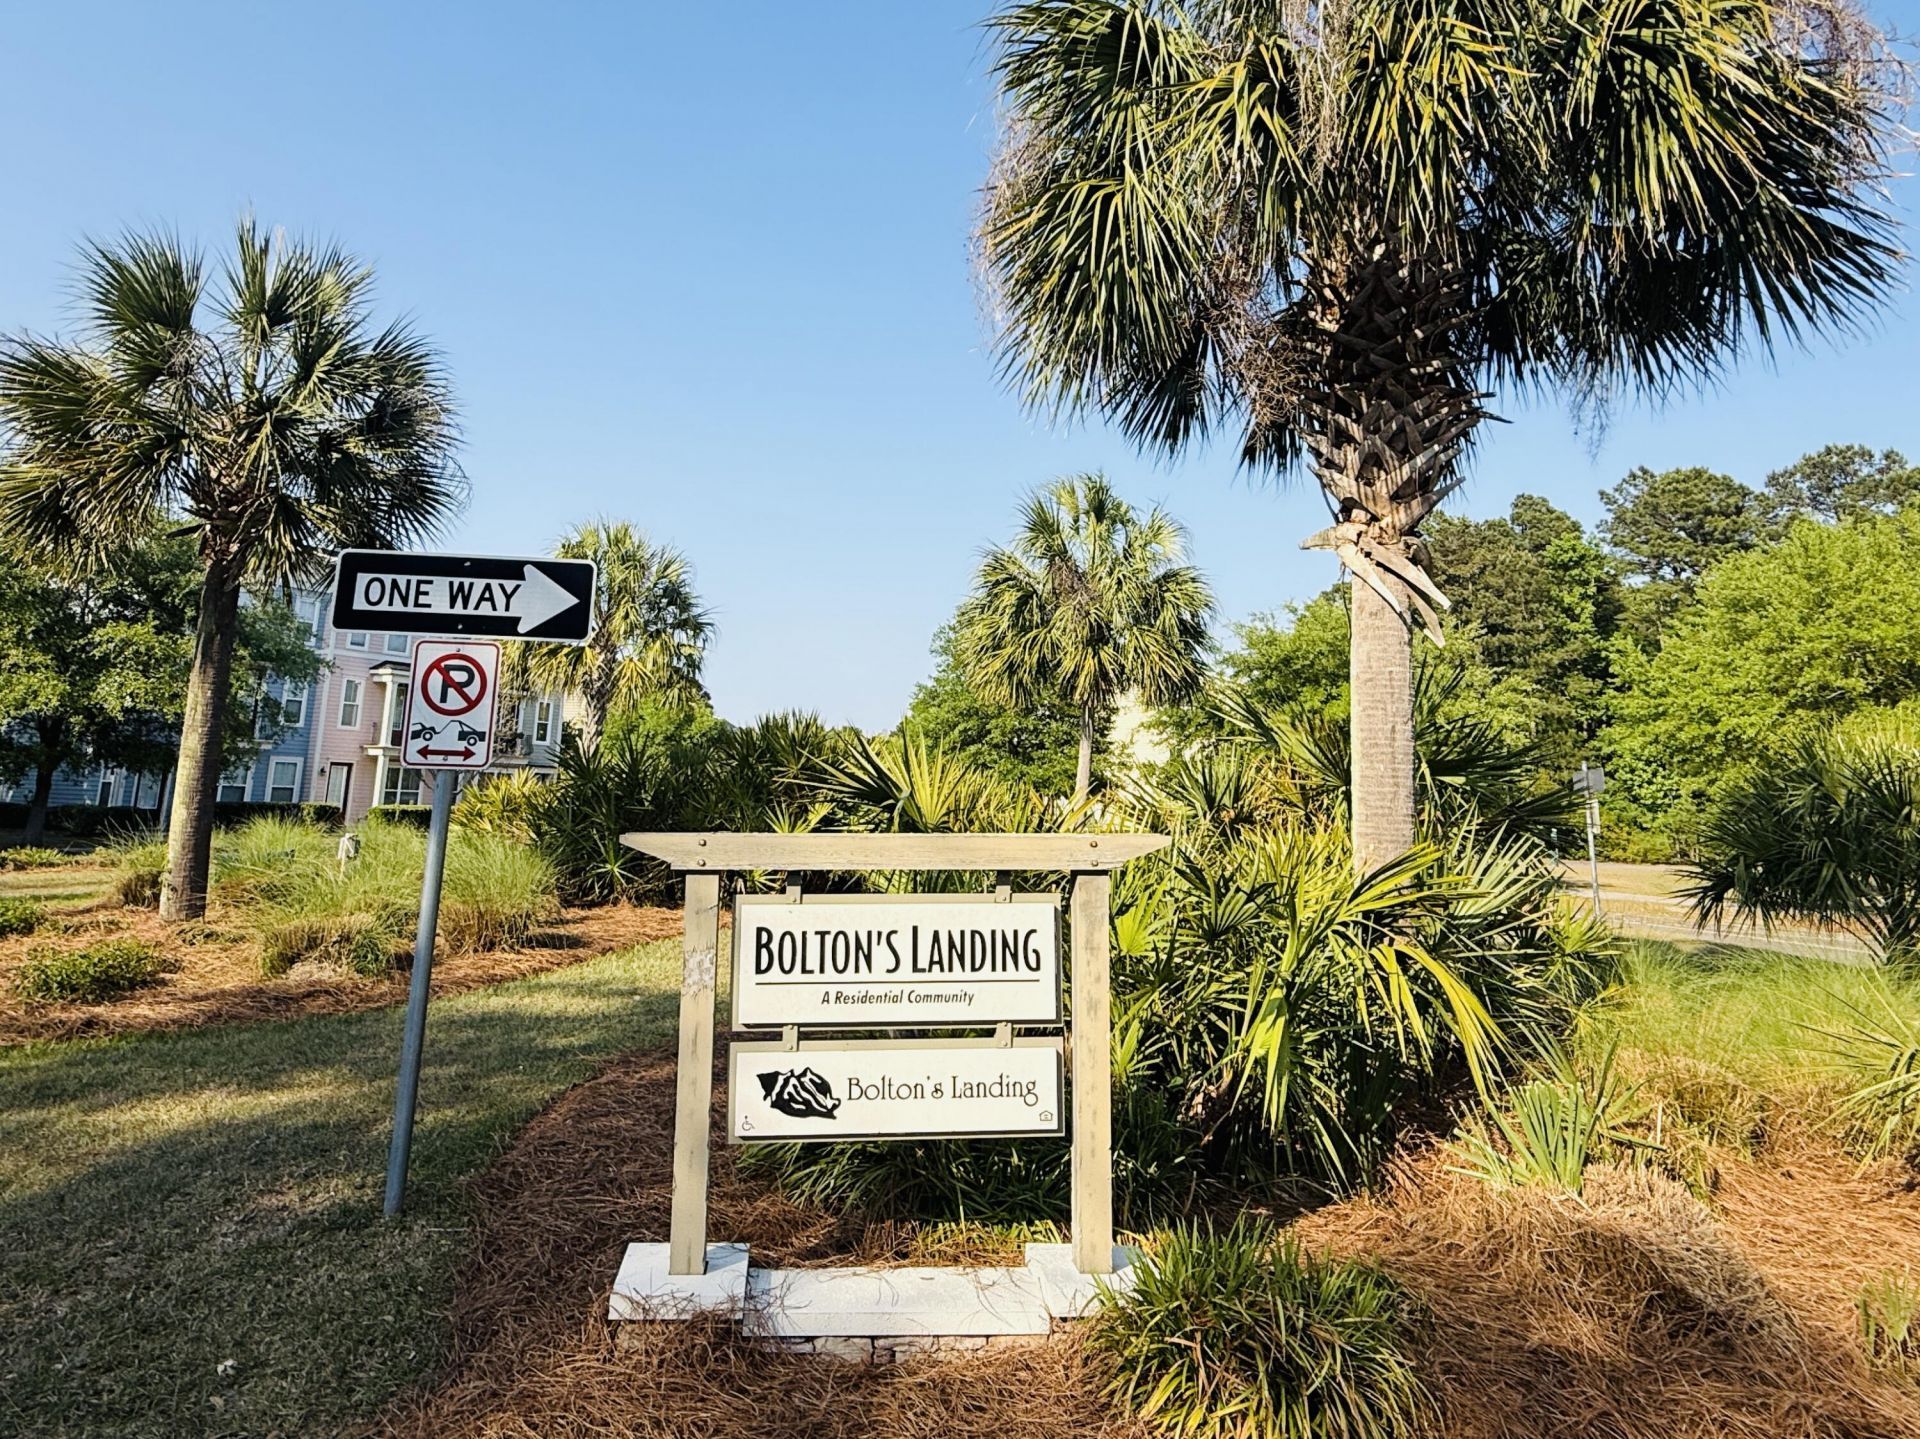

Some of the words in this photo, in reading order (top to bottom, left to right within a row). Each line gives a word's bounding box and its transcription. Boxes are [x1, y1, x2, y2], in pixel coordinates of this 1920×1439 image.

[364, 577, 434, 609] ONE
[448, 580, 522, 612] WAY
[755, 926, 901, 975] BOLTON'S
[911, 925, 1042, 974] LANDING
[821, 991, 831, 1005] A
[834, 989, 903, 1005] Residential
[907, 989, 975, 1006] Community
[847, 1075, 944, 1101] Bolton's
[951, 1073, 1039, 1107] Landing
